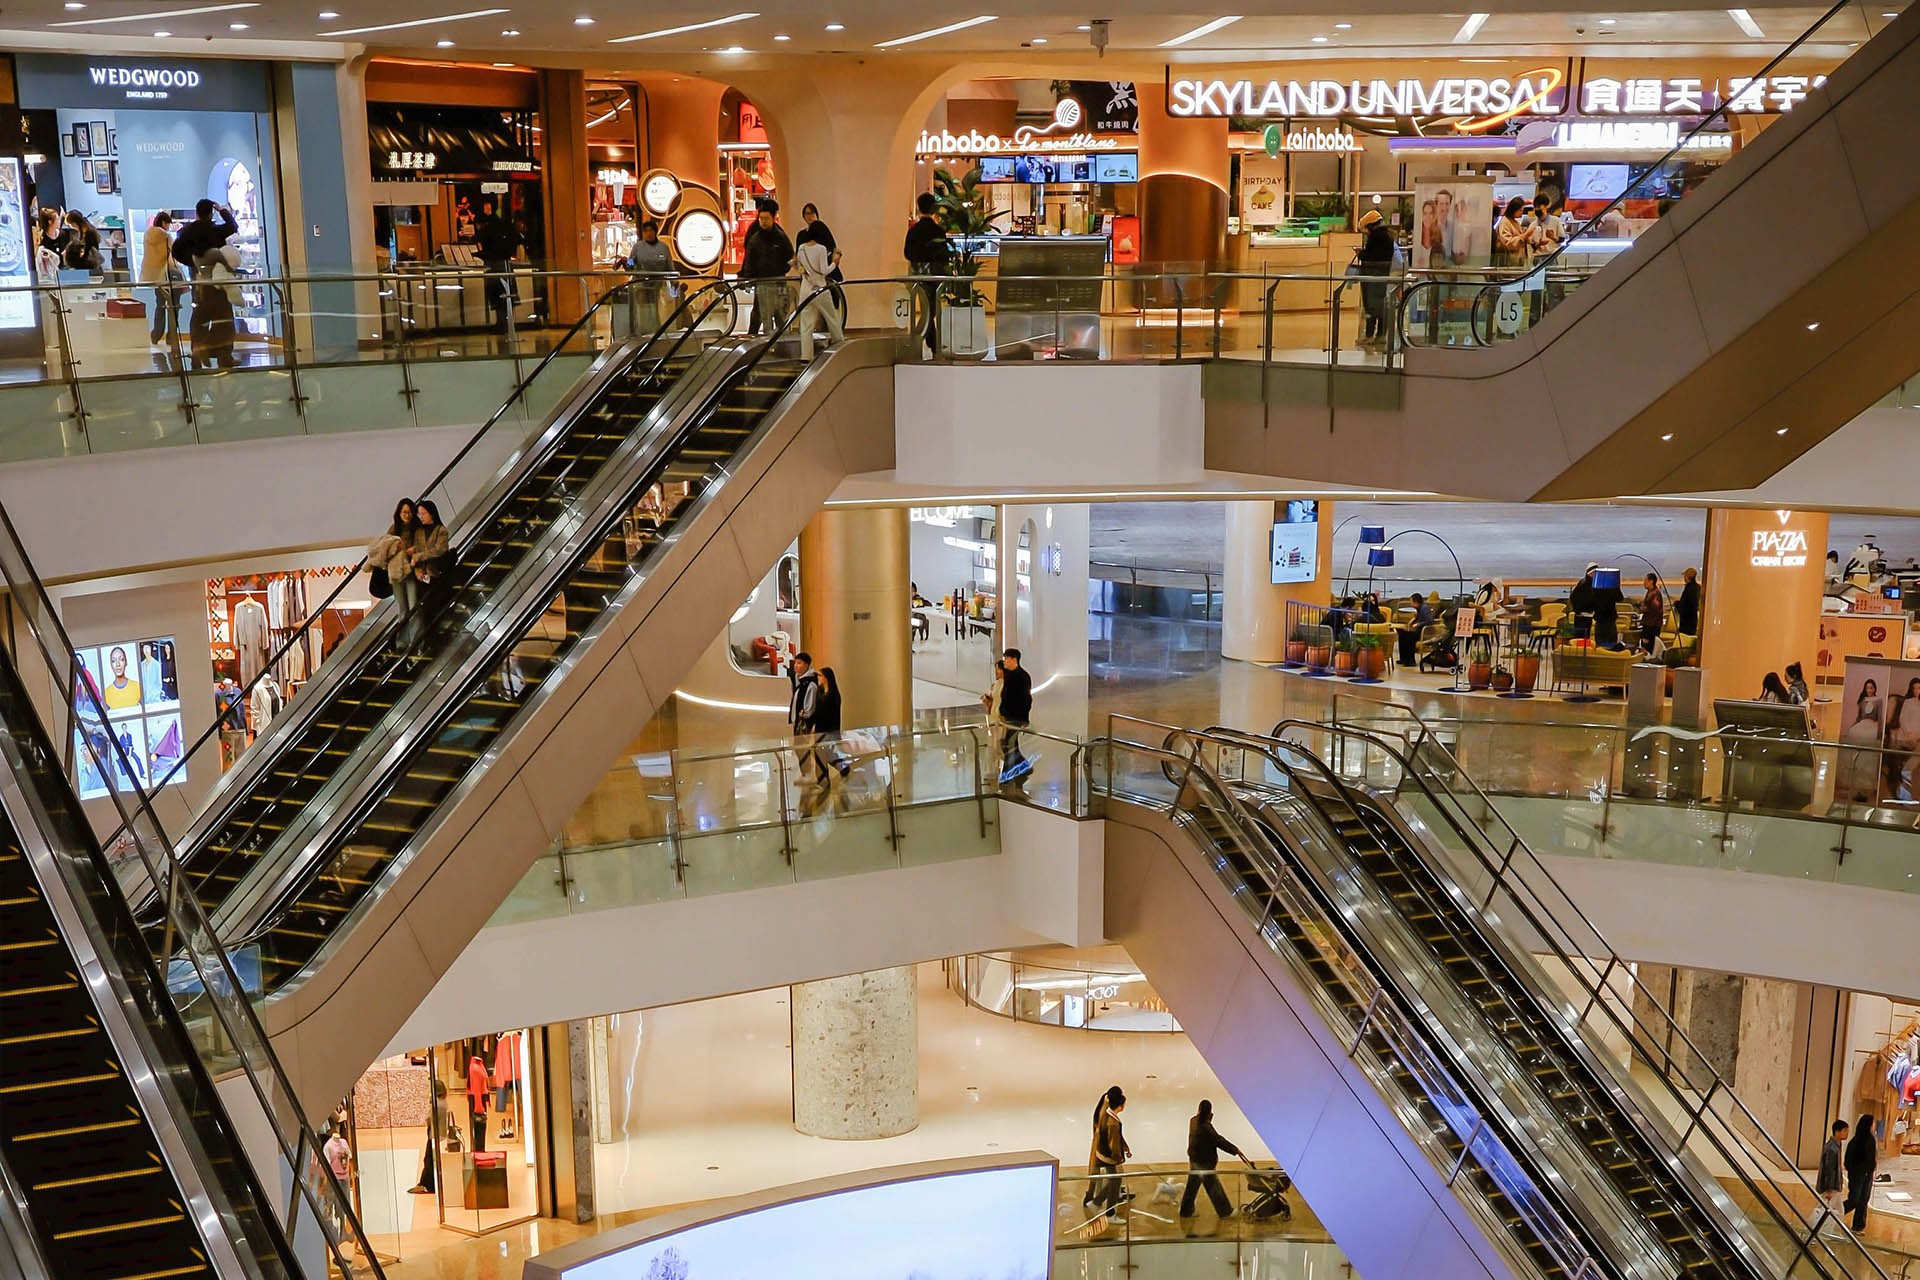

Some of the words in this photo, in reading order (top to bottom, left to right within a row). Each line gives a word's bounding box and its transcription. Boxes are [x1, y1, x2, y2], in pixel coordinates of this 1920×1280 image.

[90, 67, 199, 87] WEDGWOOD
[126, 90, 155, 98] ENGLAND
[1171, 80, 1346, 116] SKYLAND
[1351, 79, 1560, 115] UNIVERSAL
[1584, 77, 1703, 113] 食通天
[1727, 75, 1828, 113] 寰宇
[136, 142, 185, 153] WEDGWOOD
[1286, 127, 1354, 150] rainbobo
[1244, 177, 1282, 186] BIRTHDAY
[1251, 202, 1273, 211] CAKE
[1500, 302, 1518, 321] L5
[1752, 531, 1808, 552] PIAZZA
